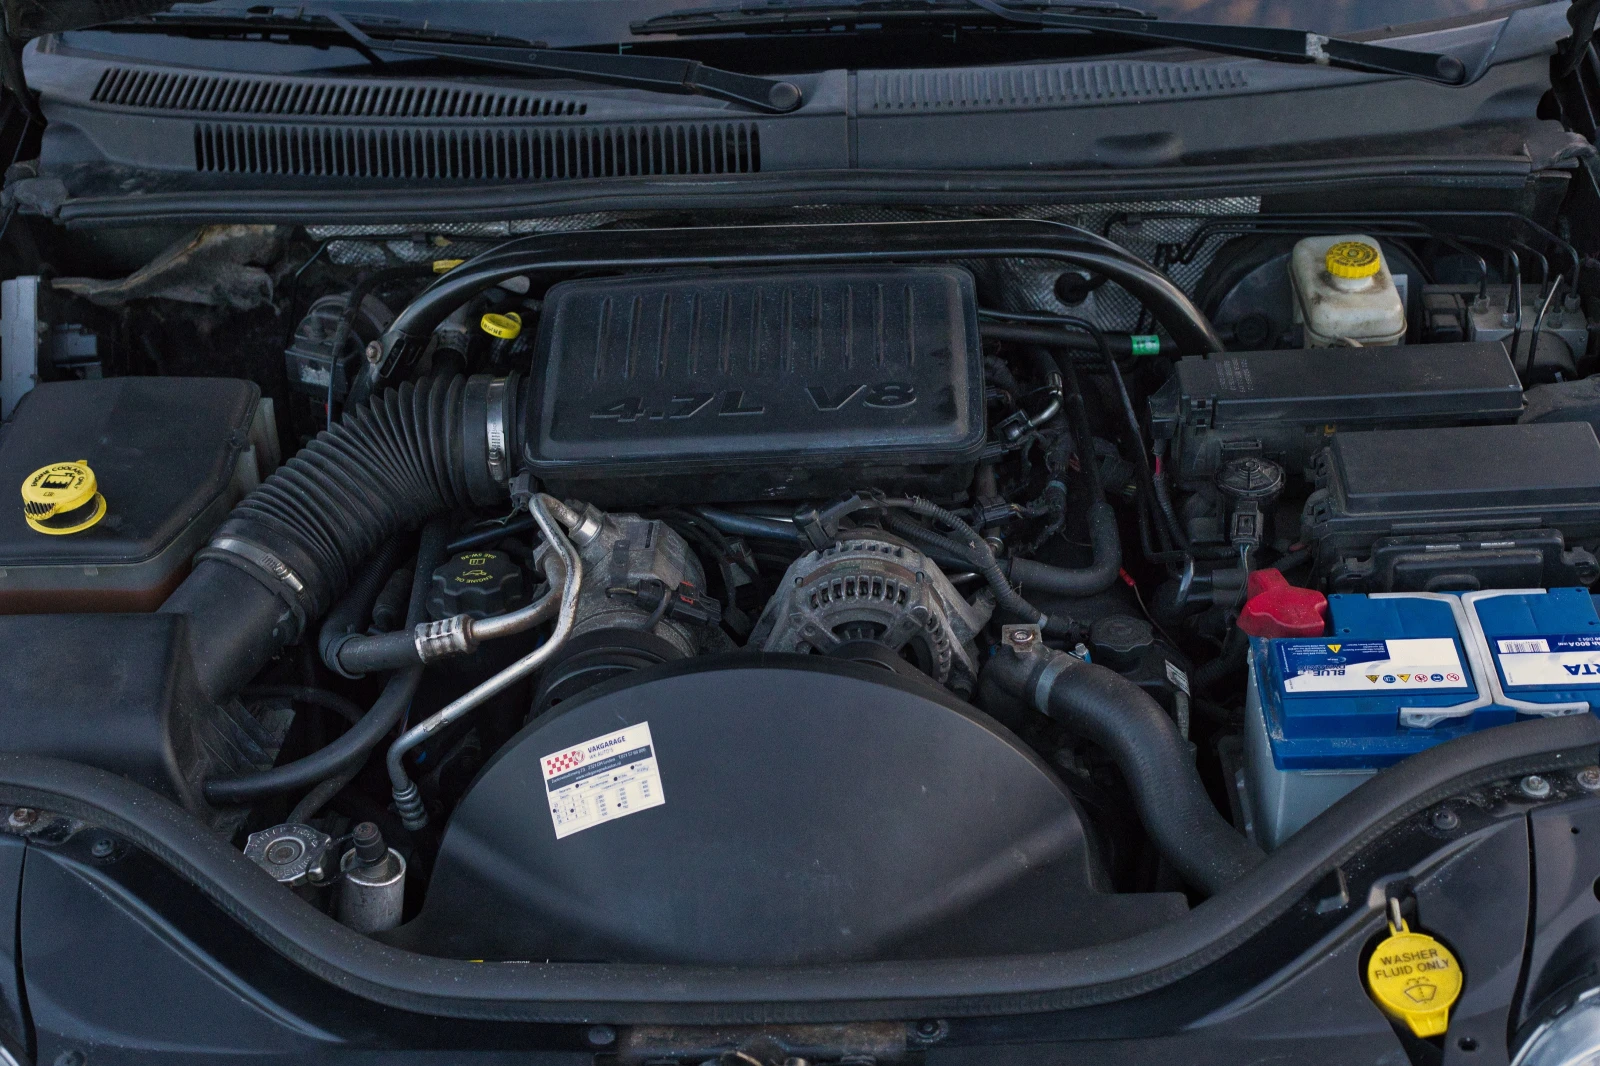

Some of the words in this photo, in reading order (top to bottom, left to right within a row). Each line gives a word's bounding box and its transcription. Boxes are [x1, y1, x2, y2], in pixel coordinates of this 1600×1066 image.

[590, 391, 765, 422] 4.7L
[804, 382, 917, 411] V8
[31, 469, 50, 488] ENGINE
[52, 466, 84, 476] COOLANT
[588, 736, 625, 753] VAKGARAGE
[1380, 949, 1438, 966] WASHER
[1375, 966, 1413, 979] FLUID
[1417, 959, 1450, 972] ONLY
